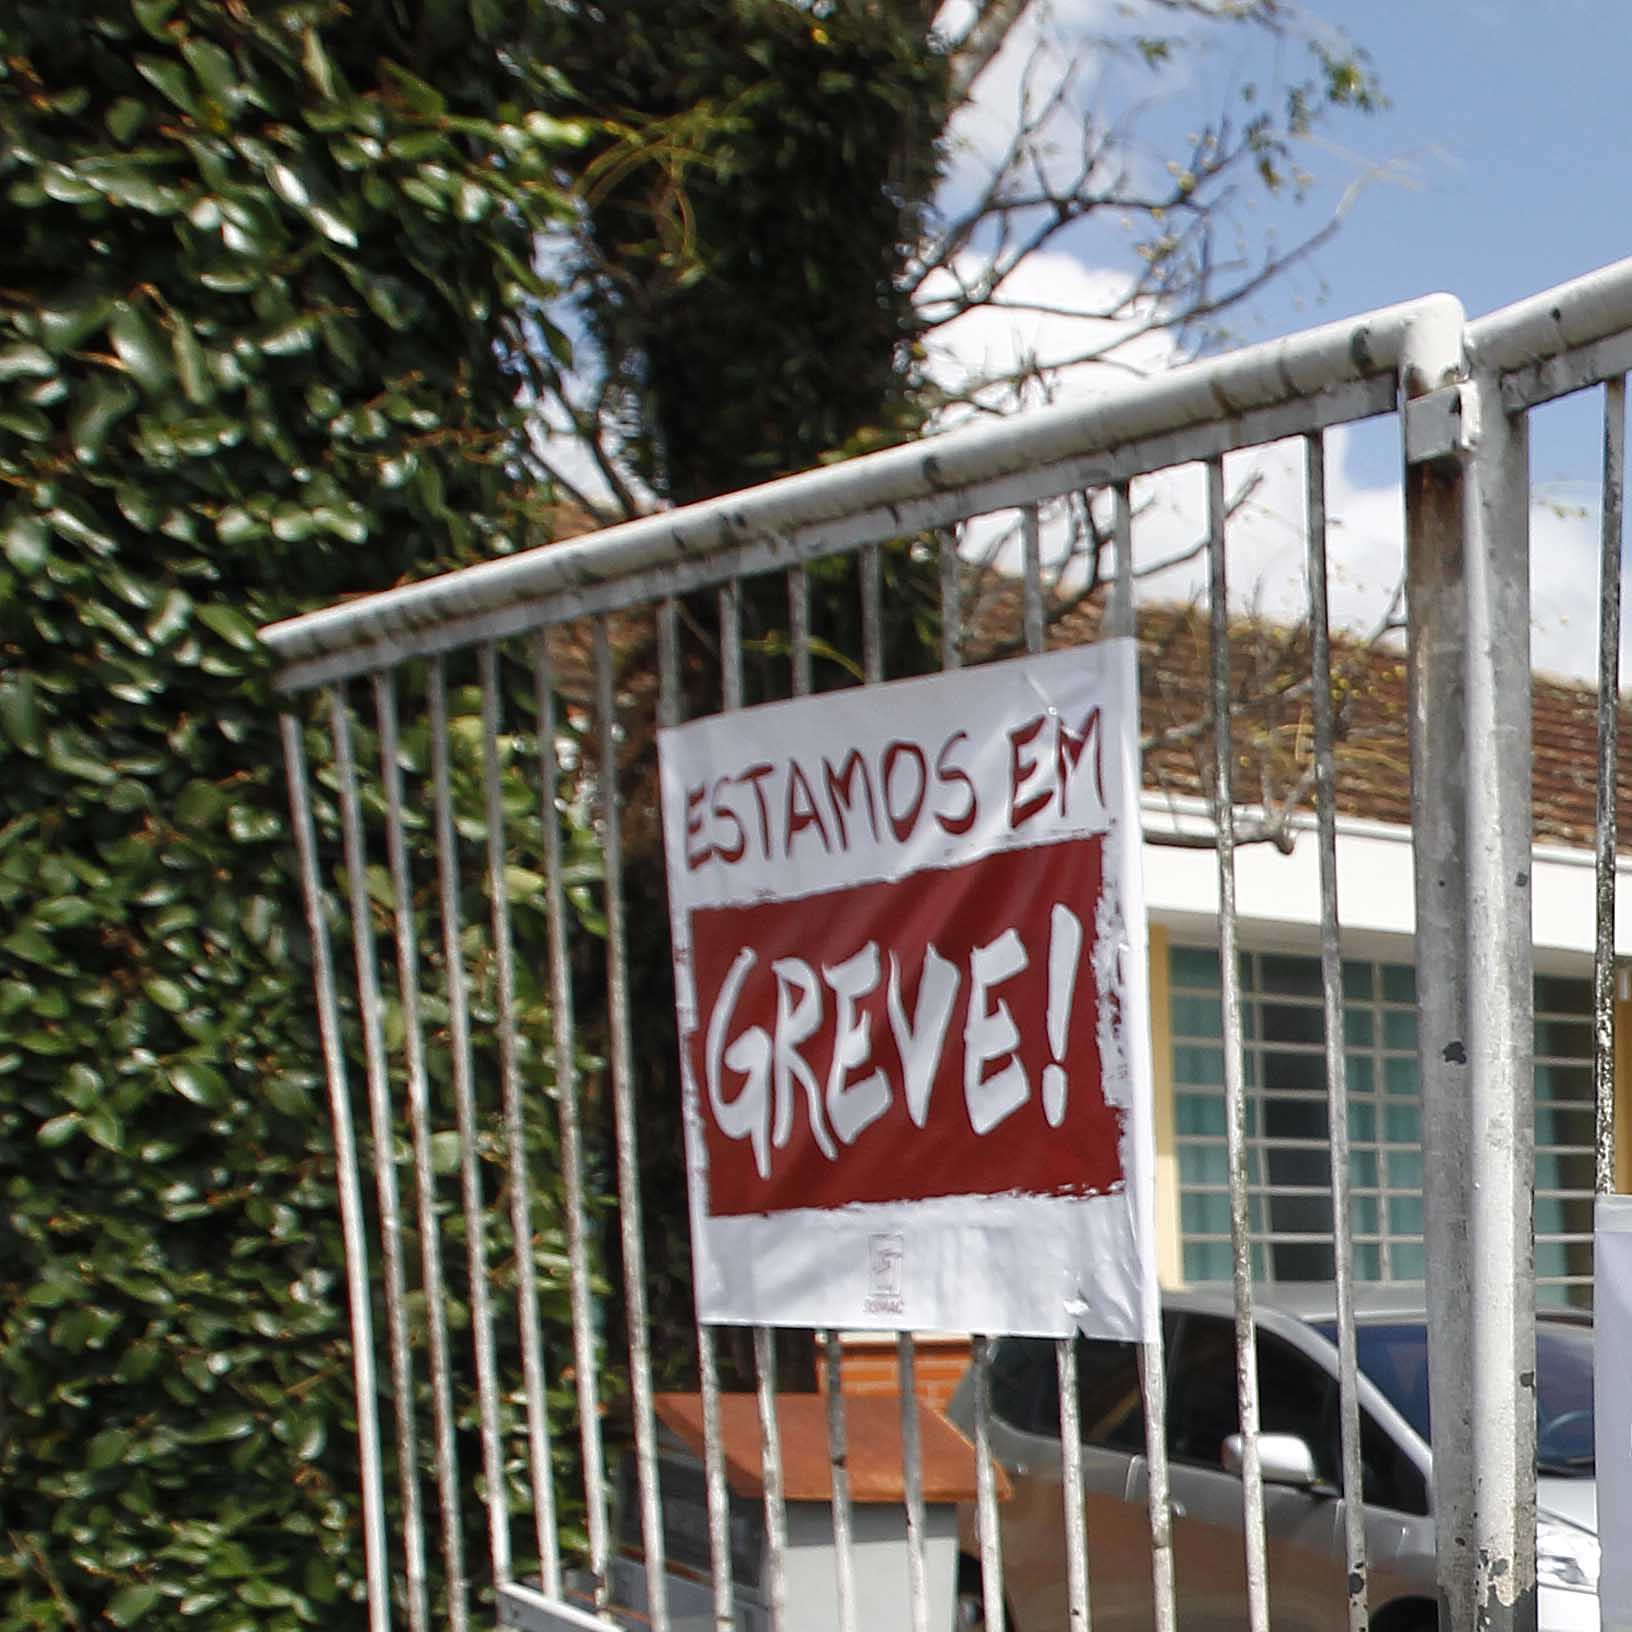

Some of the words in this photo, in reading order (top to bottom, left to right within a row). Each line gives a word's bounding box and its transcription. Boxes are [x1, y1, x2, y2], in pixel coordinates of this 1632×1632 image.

[687, 732, 978, 870] ESTAMOS
[1006, 708, 1105, 828] EM
[706, 902, 1082, 1179] GREVE!
